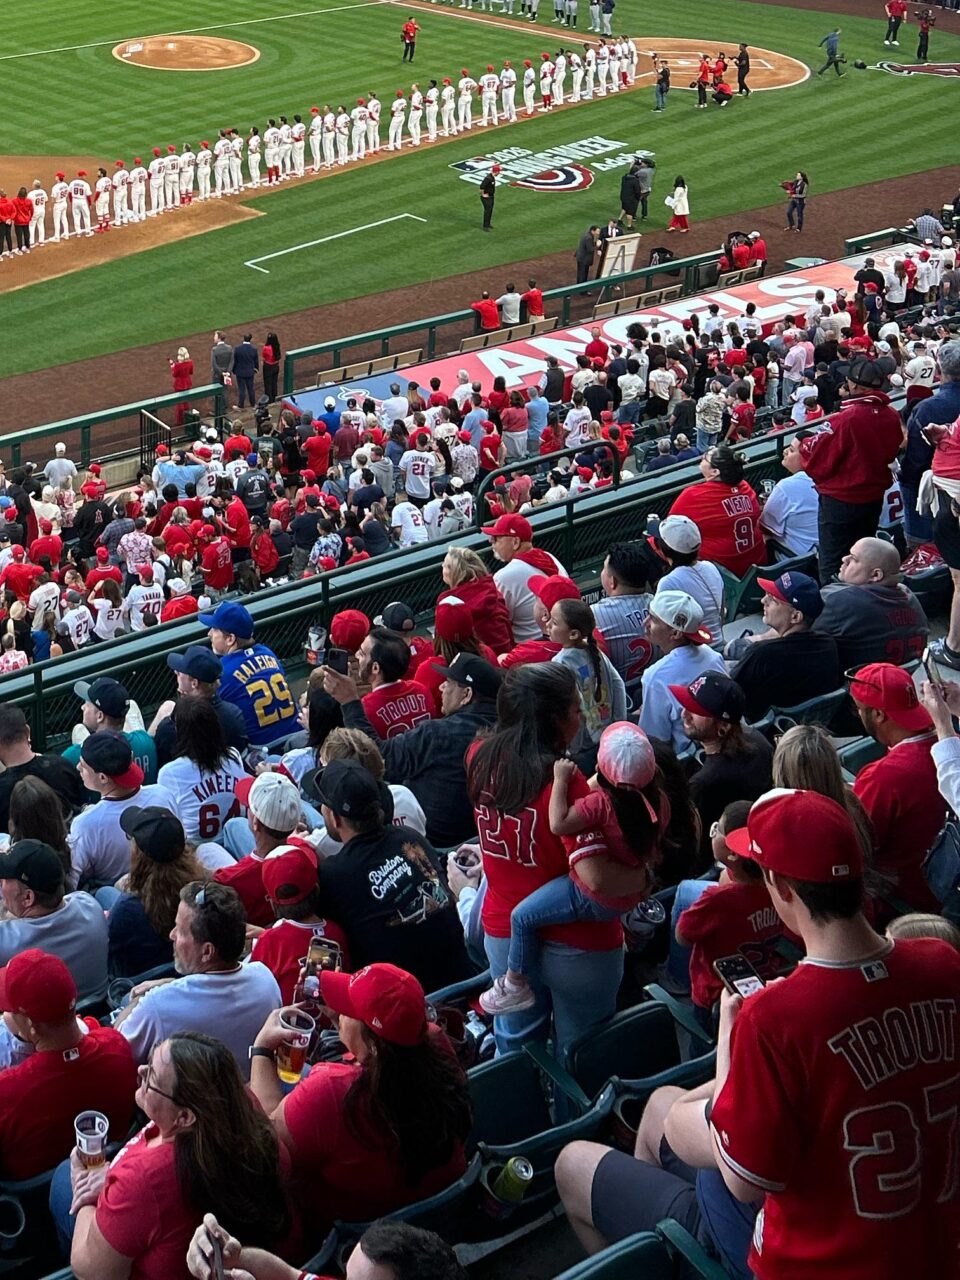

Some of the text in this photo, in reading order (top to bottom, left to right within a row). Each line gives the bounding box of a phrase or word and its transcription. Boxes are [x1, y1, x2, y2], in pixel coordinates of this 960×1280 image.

[553, 135, 629, 160] WEEK
[591, 149, 655, 171] Adobe
[476, 276, 836, 388] ANGELS
[920, 367, 934, 379] 27
[412, 463, 426, 476] 21
[721, 494, 753, 518] NETO
[733, 516, 755, 554] 9
[44, 596, 59, 612] 27
[107, 609, 122, 621] 27
[139, 601, 161, 615] 40
[75, 621, 90, 637] 27
[232, 654, 280, 684] RALEIGH
[245, 672, 296, 727] 29
[376, 693, 426, 724] TROUT
[474, 804, 538, 867] 27
[368, 854, 404, 886] Brixton
[371, 861, 412, 900] Company
[747, 906, 782, 934] TROU
[827, 998, 958, 1091] TROUT
